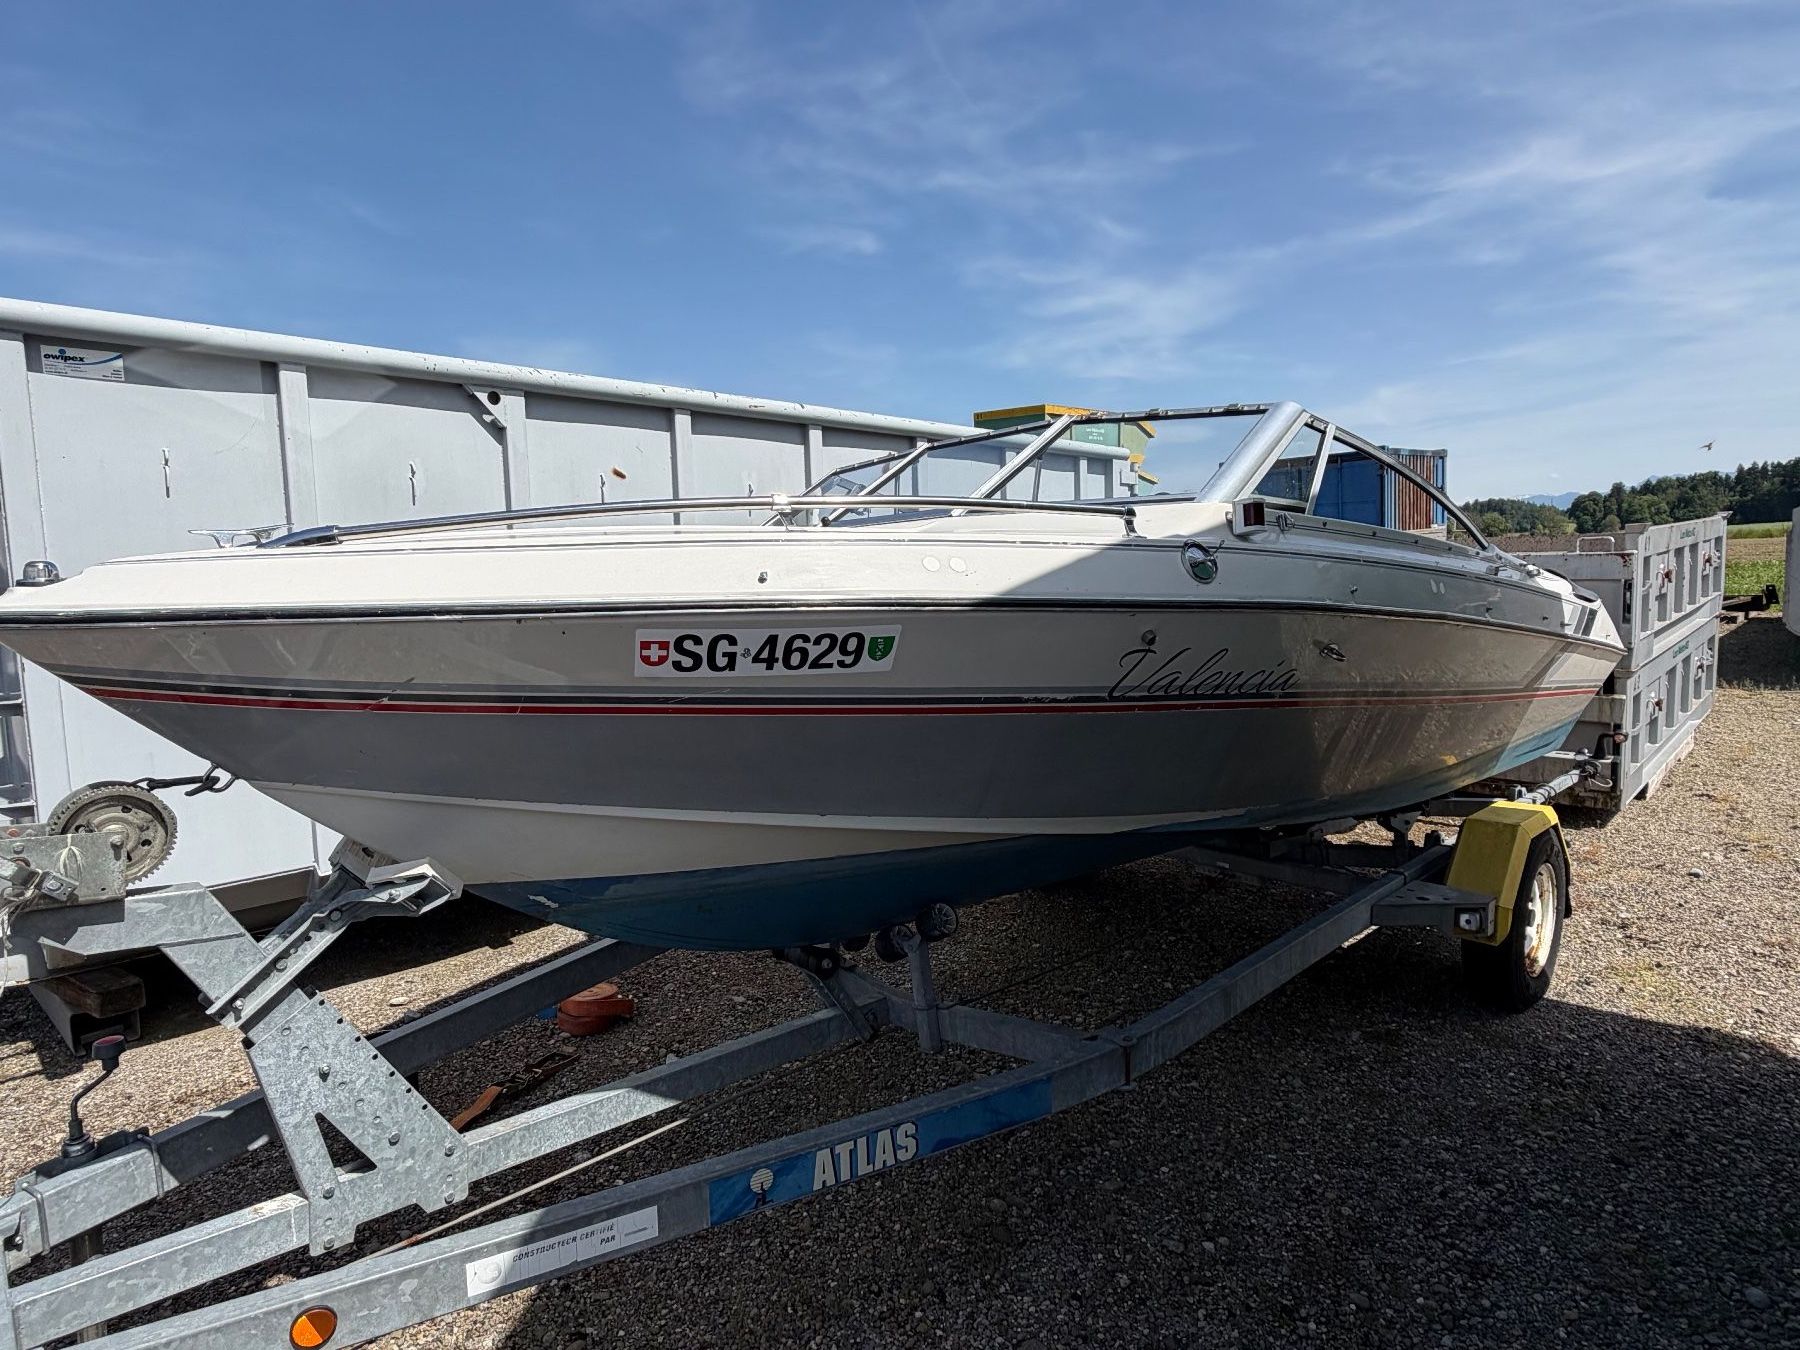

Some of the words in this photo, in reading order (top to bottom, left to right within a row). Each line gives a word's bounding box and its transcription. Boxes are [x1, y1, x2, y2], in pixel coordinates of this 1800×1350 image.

[43, 349, 85, 362] owipex
[671, 633, 738, 673] SG
[751, 632, 866, 671] 4629
[1107, 647, 1300, 699] Valencia
[812, 1121, 918, 1192] ATLAS
[600, 1234, 616, 1246] PAR
